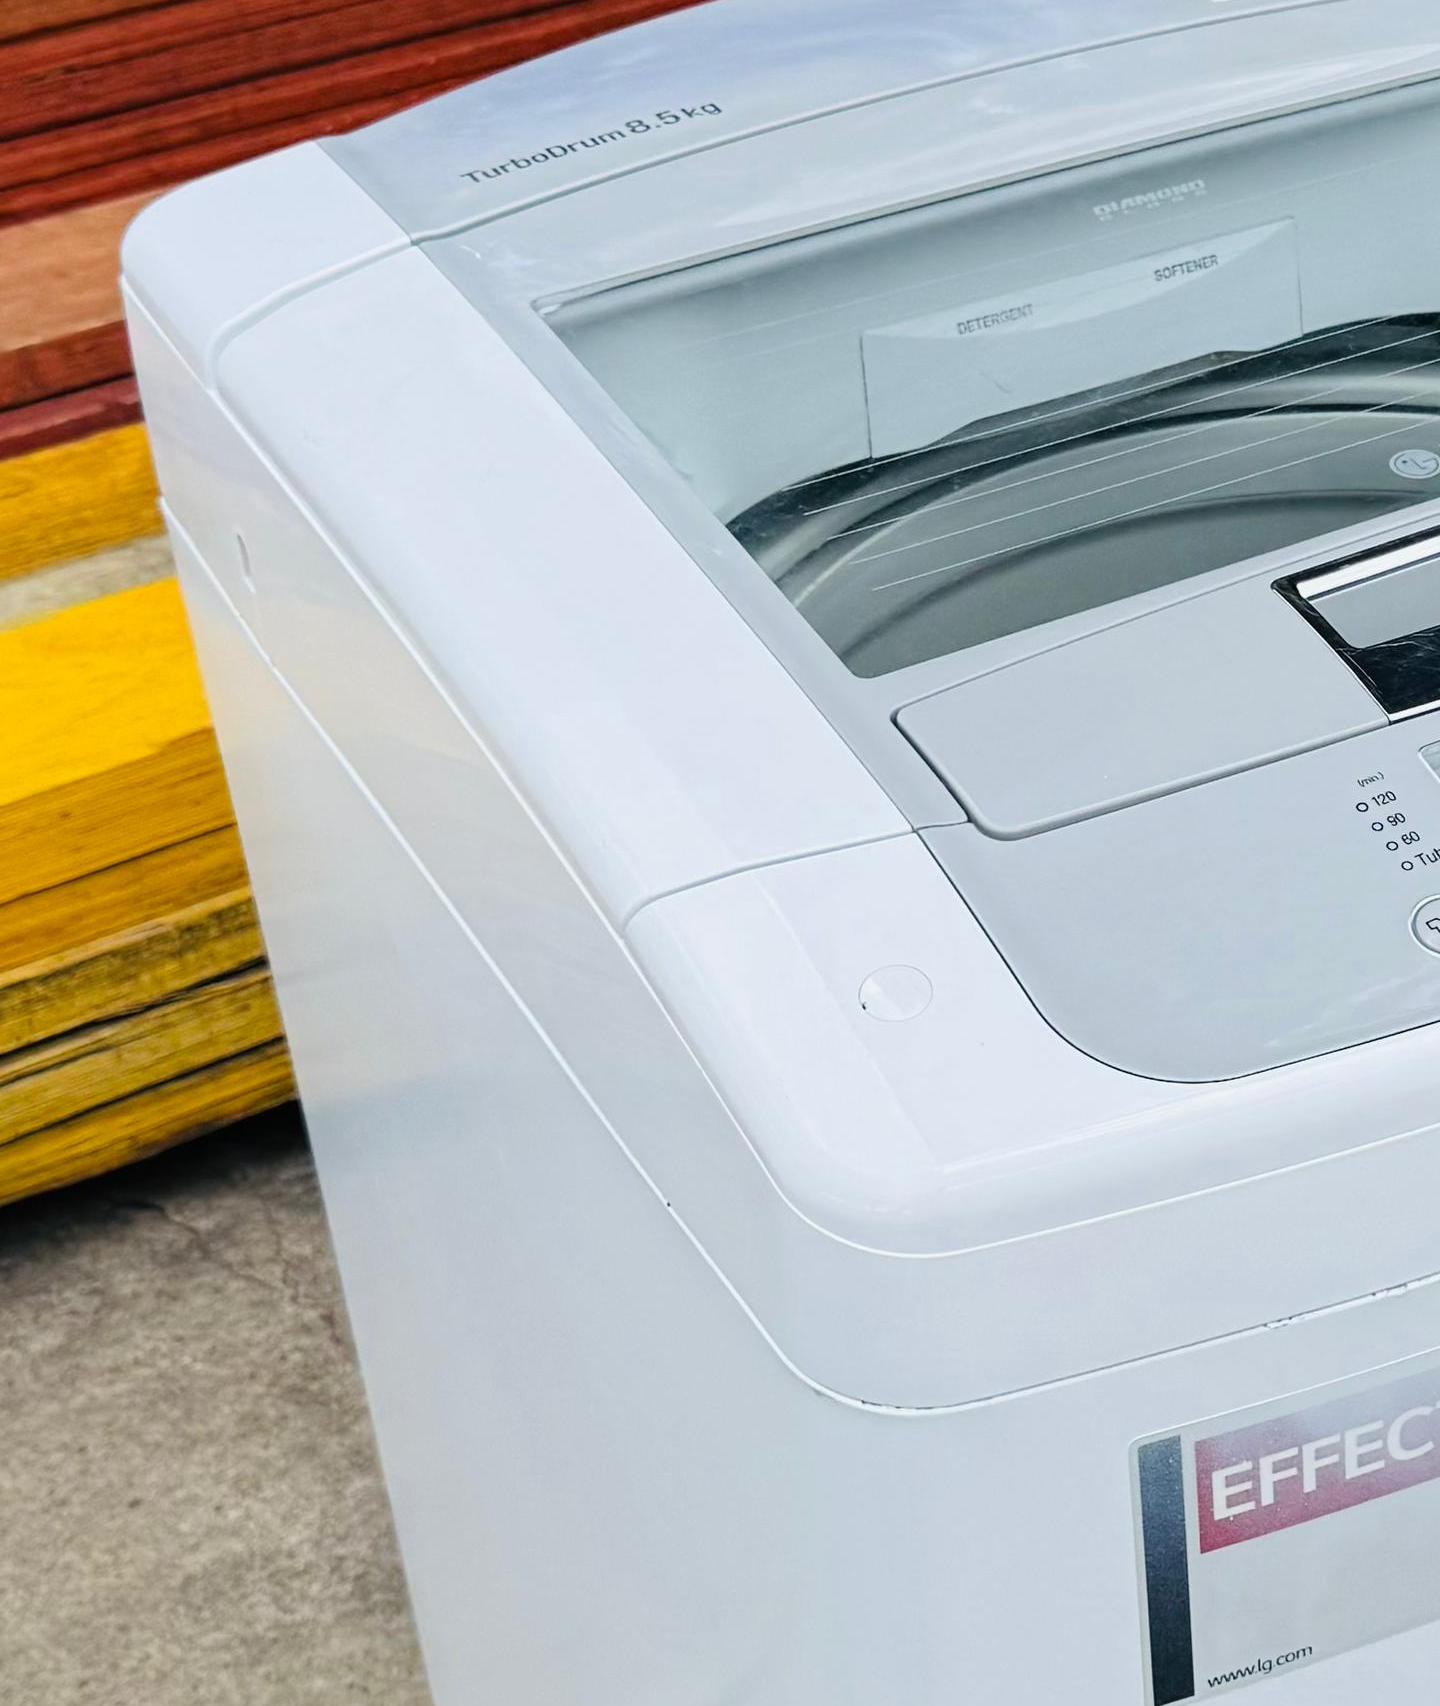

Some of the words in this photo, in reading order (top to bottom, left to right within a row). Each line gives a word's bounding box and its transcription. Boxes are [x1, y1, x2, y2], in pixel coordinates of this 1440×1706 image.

[460, 127, 627, 184] TurboDrum
[1154, 254, 1219, 282] SOFTENER
[957, 304, 1035, 335] DETERGENT
[1371, 790, 1397, 806] 120
[1386, 812, 1406, 827] 90
[1207, 1645, 1314, 1689] www.lg.com
